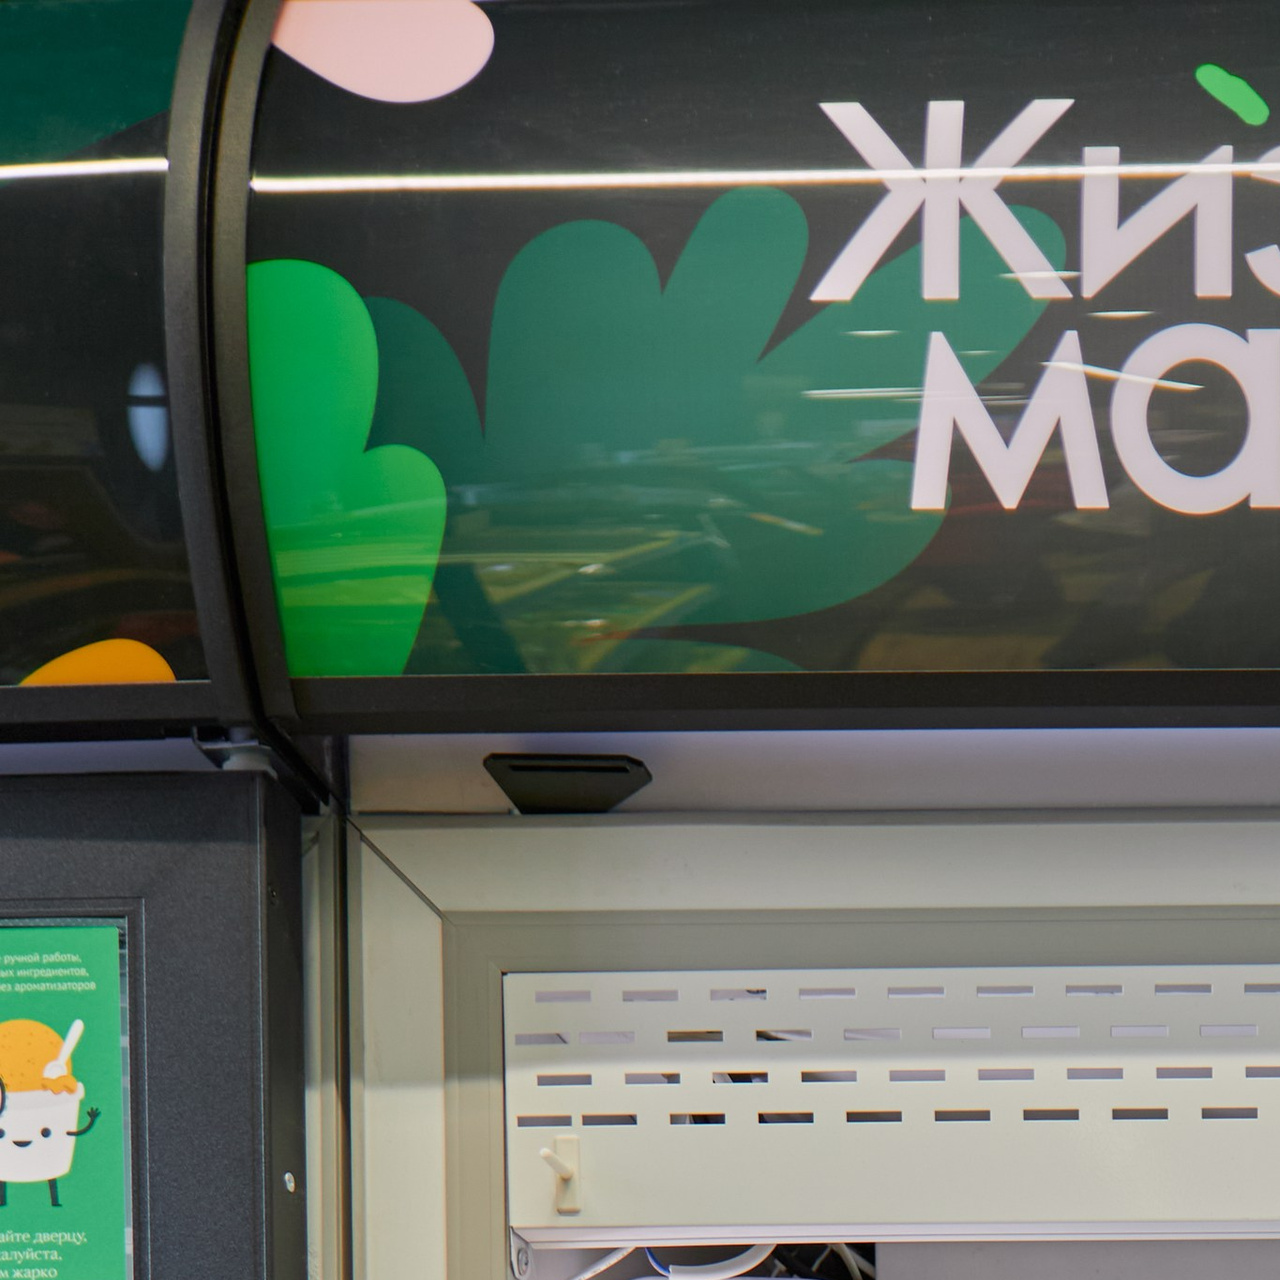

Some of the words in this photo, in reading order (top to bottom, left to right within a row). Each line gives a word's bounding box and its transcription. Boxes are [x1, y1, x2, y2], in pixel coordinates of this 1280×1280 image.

[4, 953, 39, 965] ручной
[15, 982, 96, 993] ароматизаторов
[12, 1268, 58, 1280] жарко
